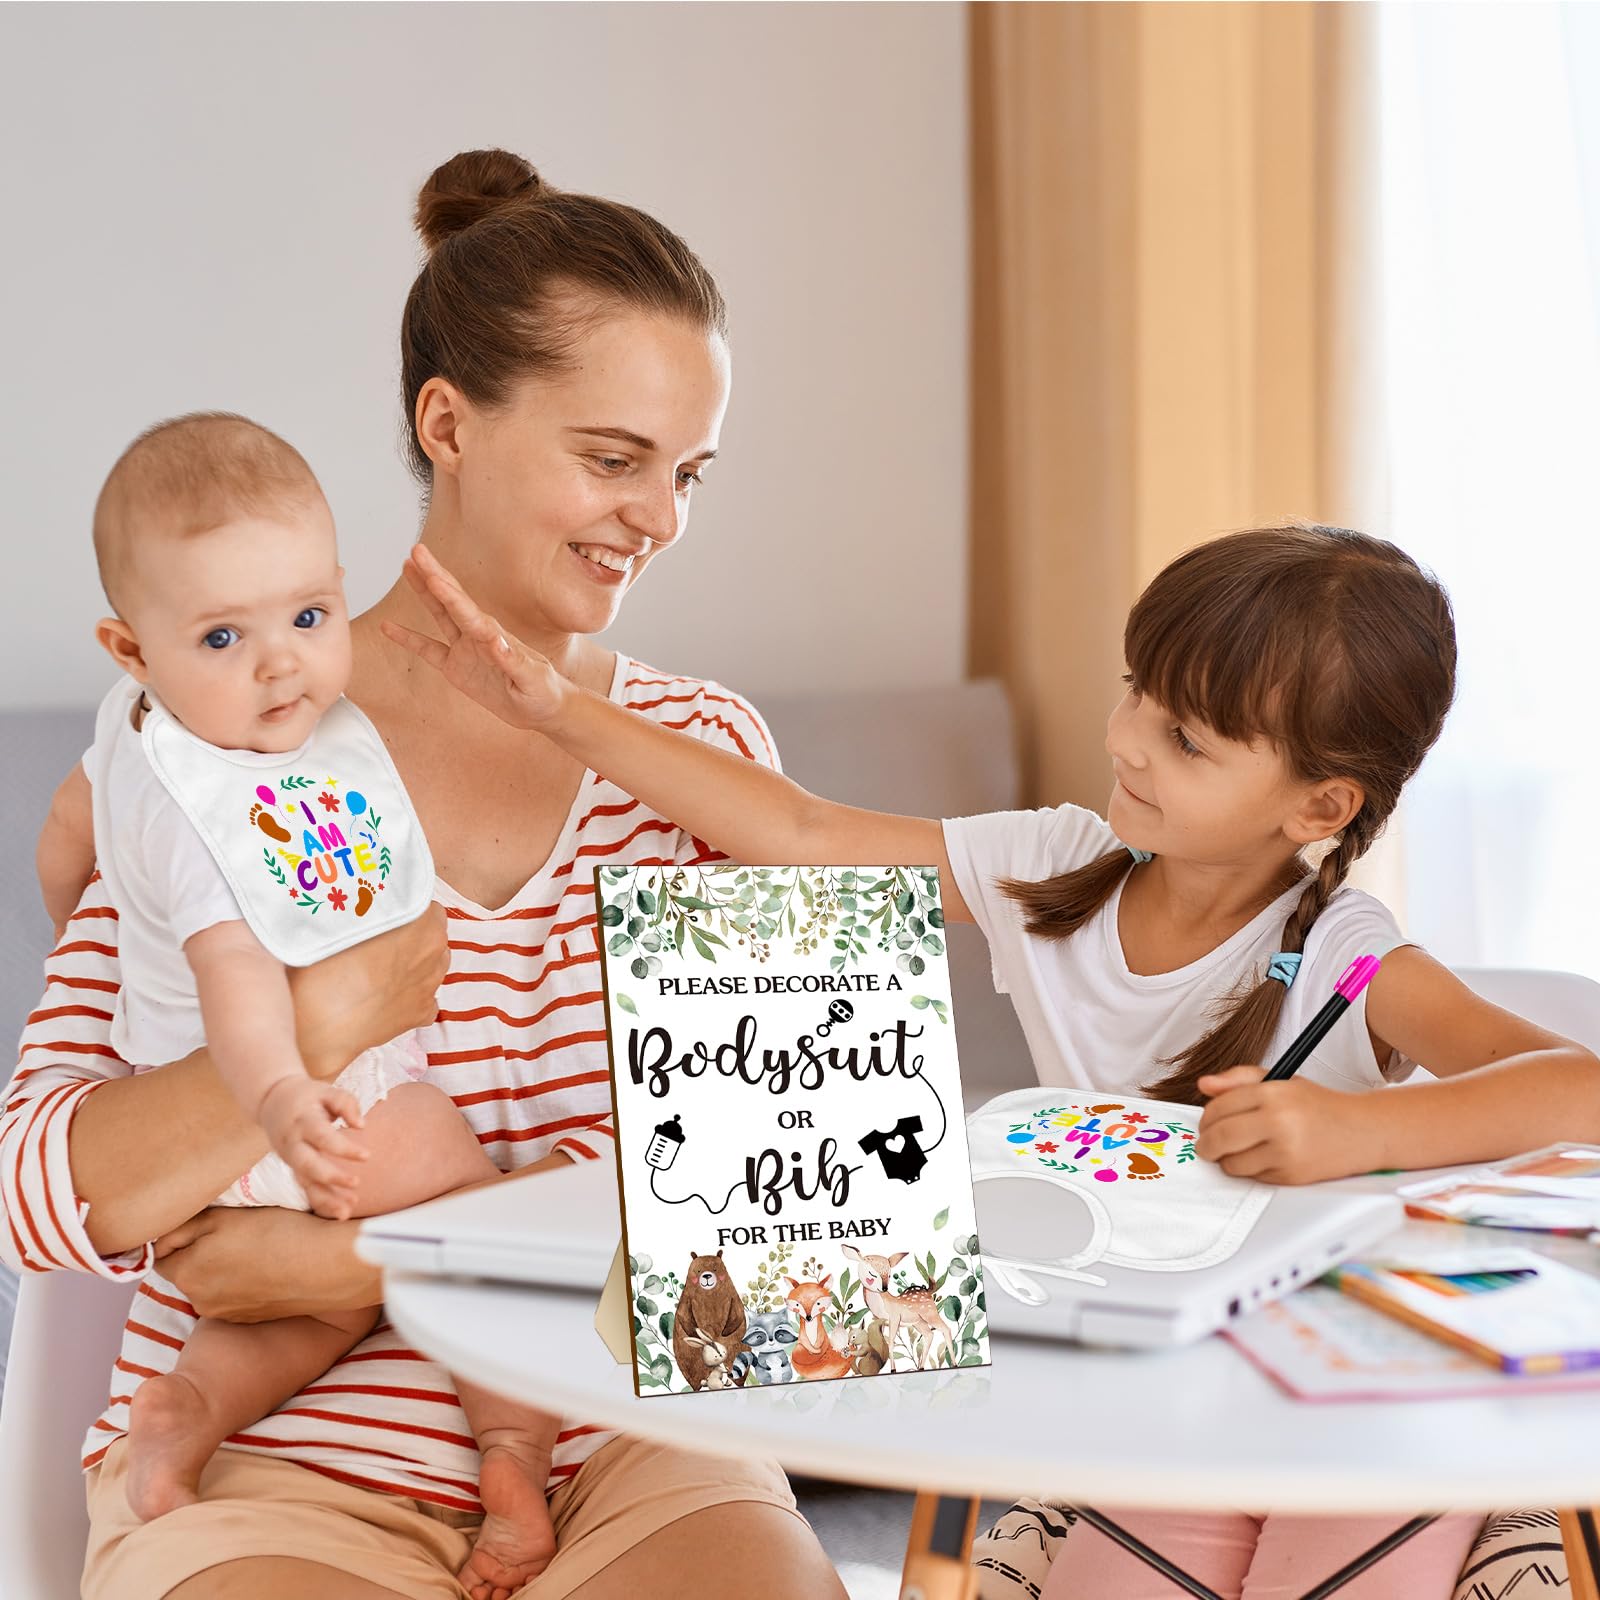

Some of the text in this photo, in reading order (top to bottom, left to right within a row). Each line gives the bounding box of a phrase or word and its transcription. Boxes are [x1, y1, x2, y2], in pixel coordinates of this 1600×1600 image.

[303, 822, 347, 857] AM
[297, 843, 377, 891] CUTE
[658, 973, 903, 996] PLEASE DECORATE A
[628, 1014, 925, 1099] Bodysuit
[777, 1110, 815, 1129] OR
[1051, 1113, 1171, 1143] CUTE
[1065, 1129, 1131, 1151] AM
[745, 1137, 863, 1216] Bib
[716, 1217, 892, 1247] FOR THE BABY
